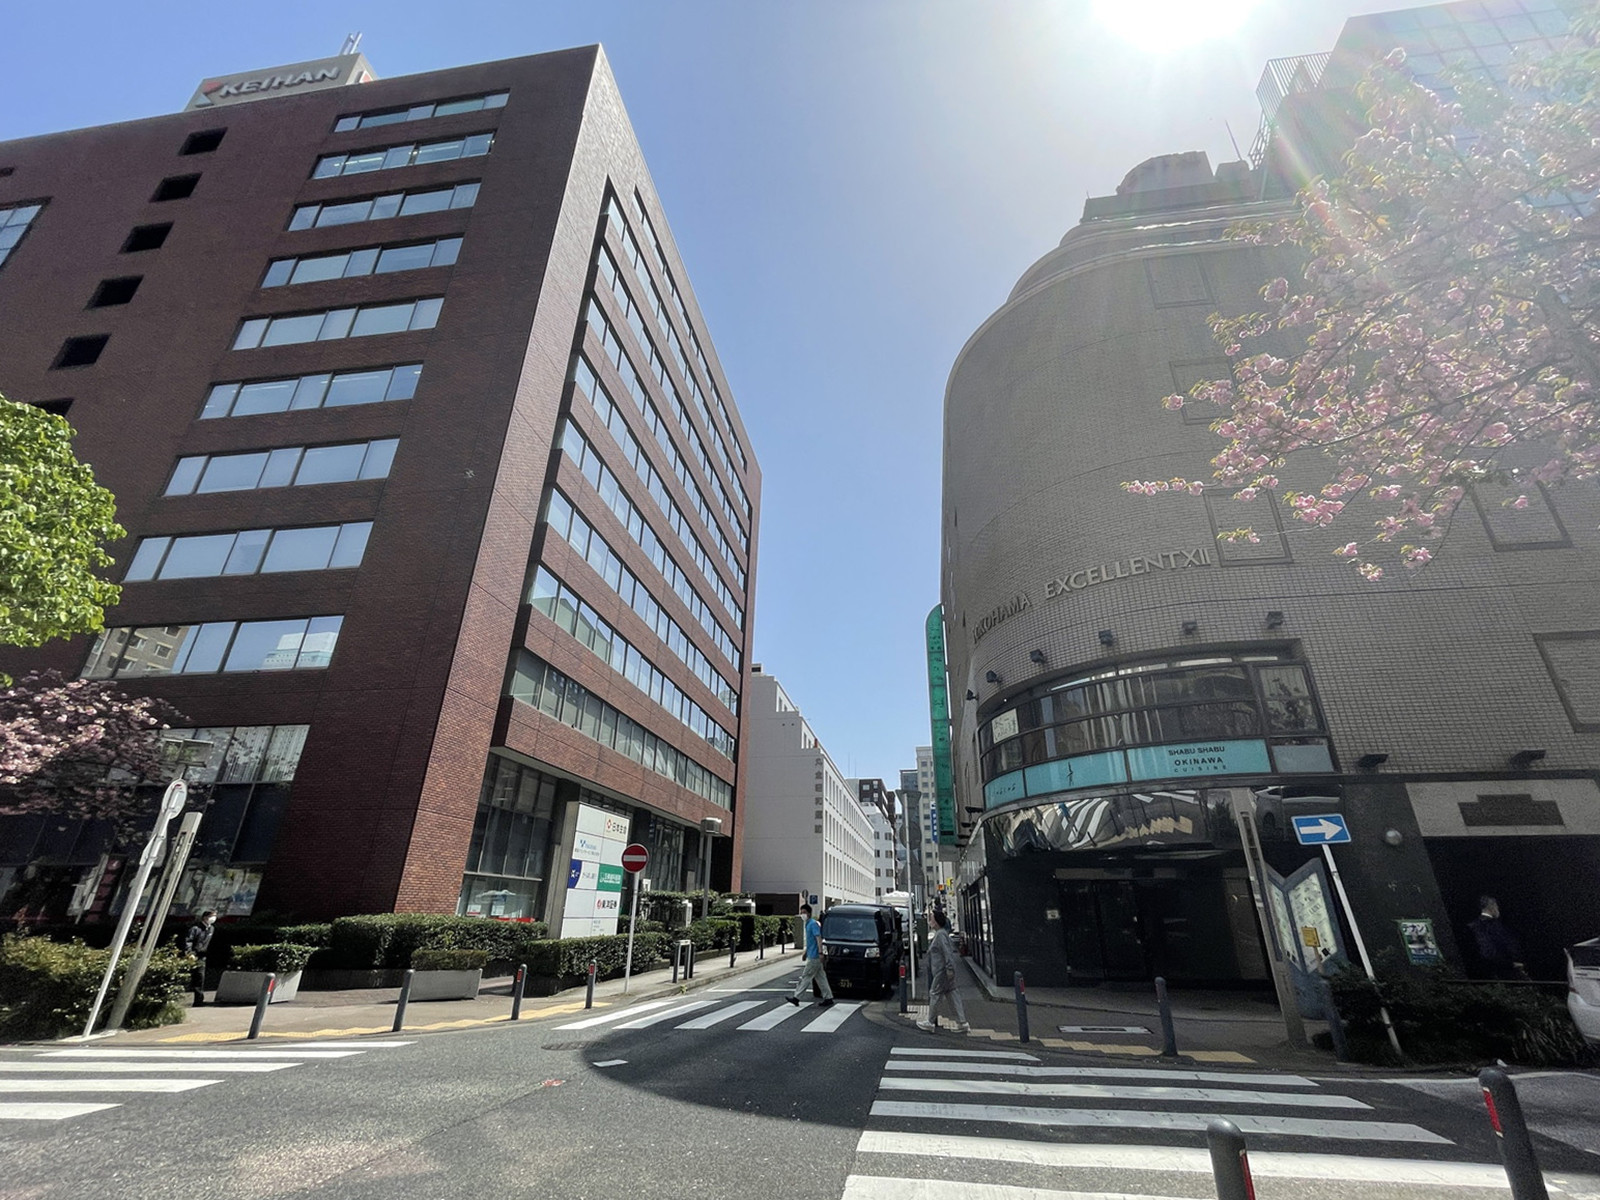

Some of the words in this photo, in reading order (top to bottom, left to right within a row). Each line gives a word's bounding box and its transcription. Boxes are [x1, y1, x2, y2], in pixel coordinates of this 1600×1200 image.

[219, 66, 341, 98] KEIHAN
[1168, 748, 1196, 756] SHABU
[1174, 757, 1223, 766] OKINAWA
